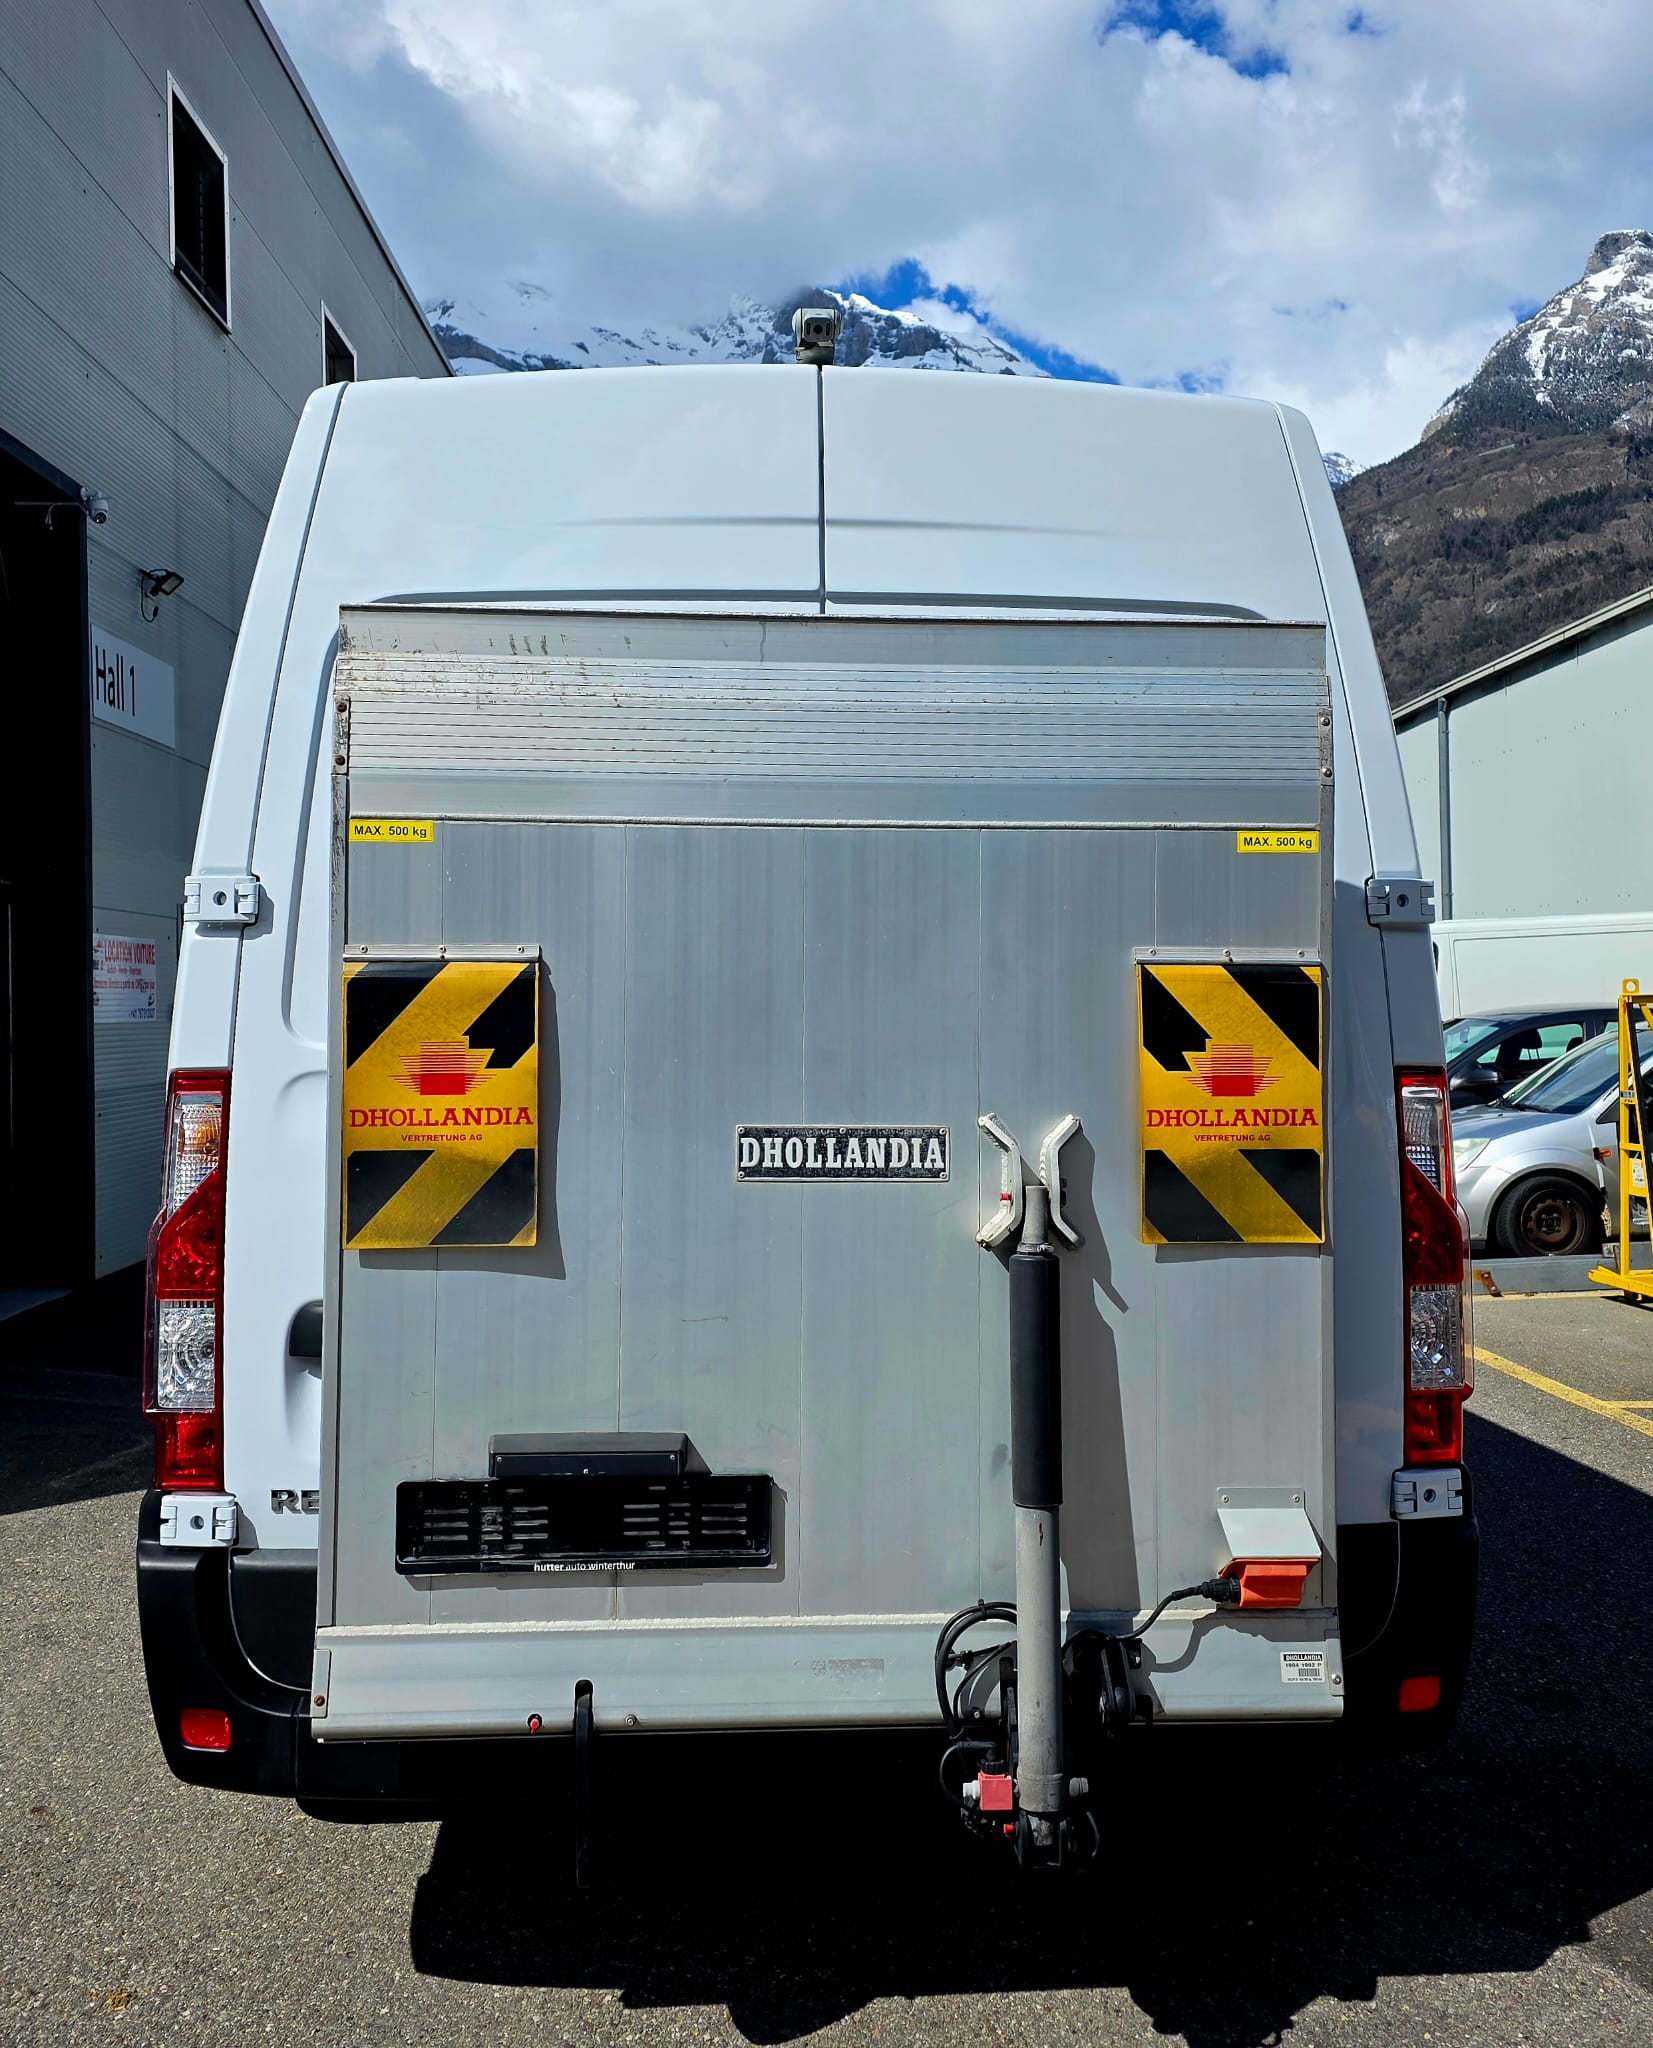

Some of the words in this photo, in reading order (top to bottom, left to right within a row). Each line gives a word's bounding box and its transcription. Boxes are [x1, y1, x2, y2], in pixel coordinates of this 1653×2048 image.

[95, 645, 125, 712] Hall
[129, 665, 136, 717] 1
[354, 825, 385, 836] MAX.
[388, 825, 409, 836] 500
[412, 826, 427, 838] kg
[1243, 837, 1273, 847] MAX.
[1276, 837, 1296, 847] 500
[1299, 837, 1312, 849] kg
[105, 940, 132, 964] LOCATION
[132, 943, 155, 966] VOITURE
[349, 1106, 534, 1128] DHOLLANDIA
[1146, 1108, 1319, 1128] DHOLLANDIA
[401, 1134, 467, 1142] VERTRETUNG
[1194, 1134, 1256, 1142] VERTRETUNG
[1258, 1134, 1271, 1142] AG
[740, 1137, 945, 1169] DHOLLANDIA
[533, 1563, 564, 1572] hutter
[565, 1562, 587, 1571] auto
[587, 1561, 636, 1571] winterthur
